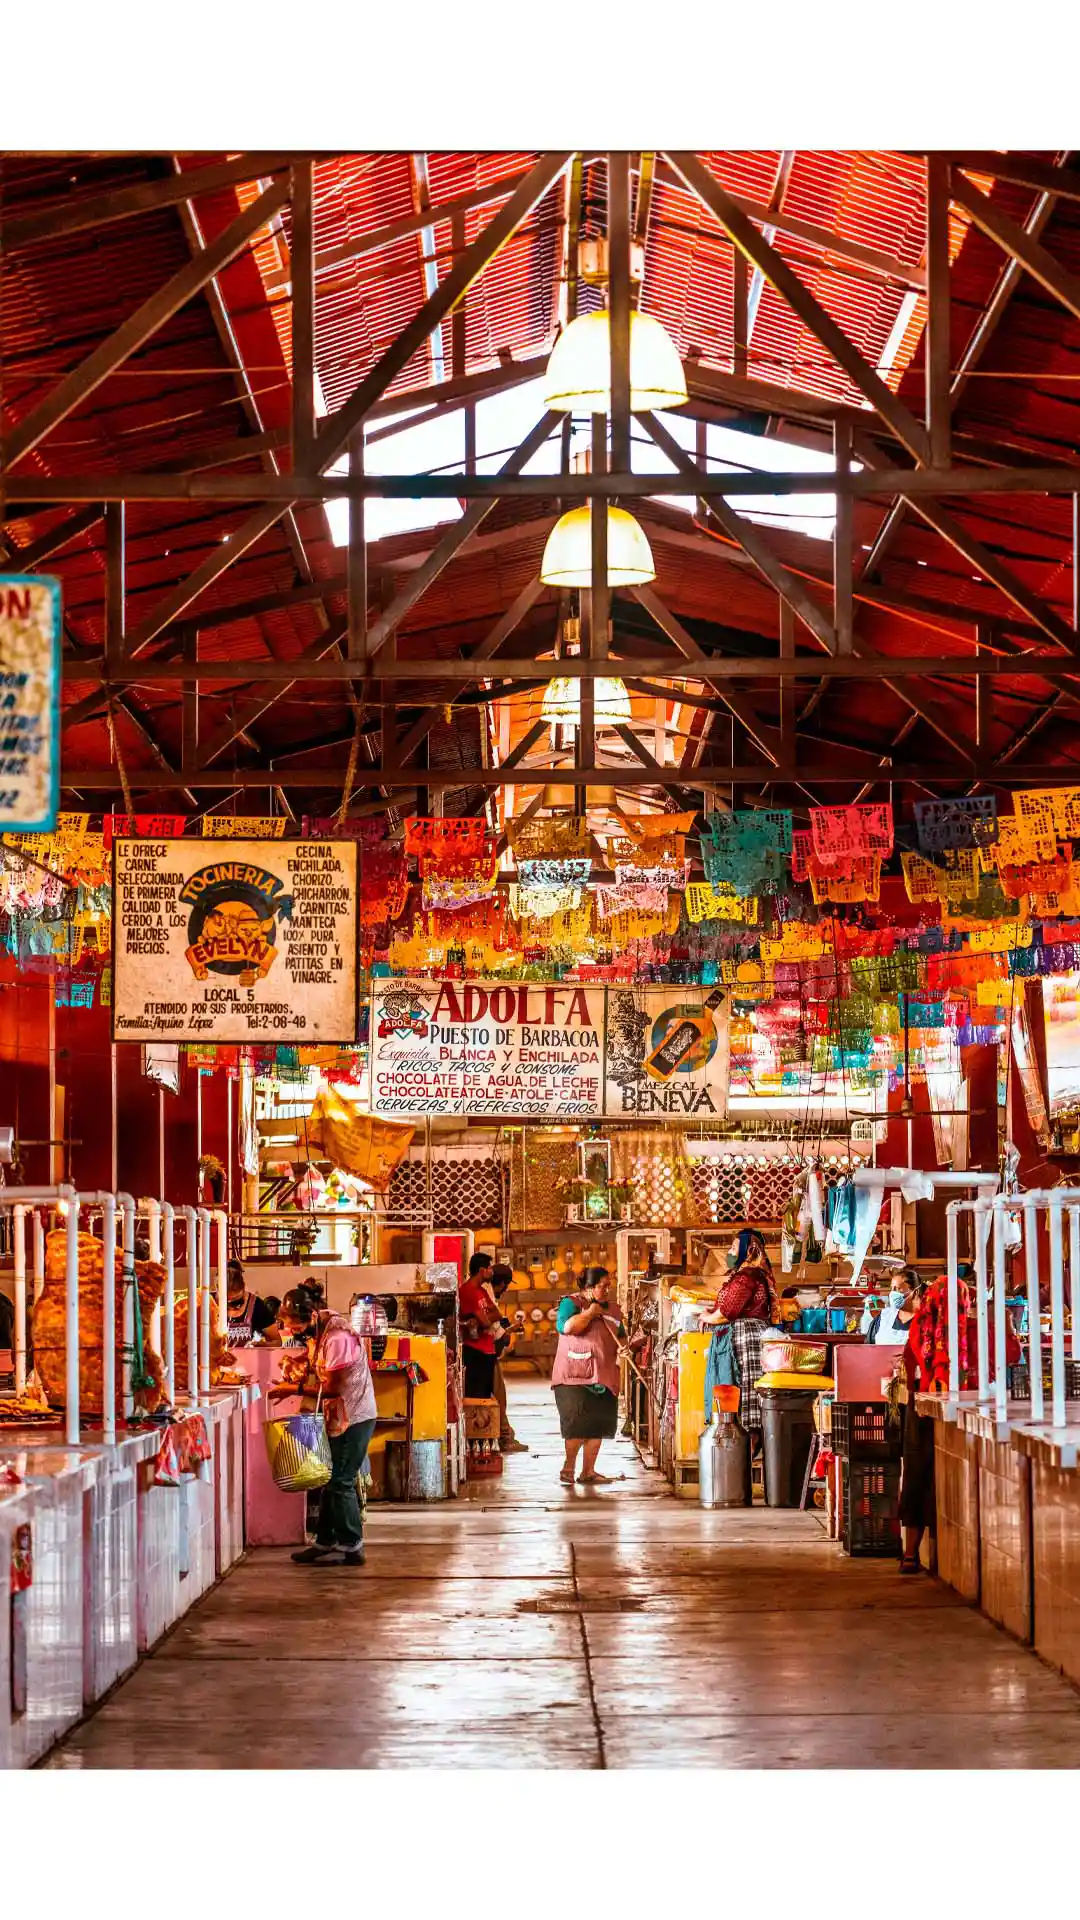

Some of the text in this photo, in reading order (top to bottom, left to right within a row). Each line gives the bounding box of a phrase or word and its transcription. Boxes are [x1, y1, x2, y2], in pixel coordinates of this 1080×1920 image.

[118, 844, 168, 857] LE OFRECE
[125, 859, 157, 871] CARNE
[118, 873, 185, 885] SELECCIONADA
[182, 863, 277, 900] TOCINERIA
[123, 887, 176, 899] DE PRIMERA
[122, 901, 177, 913] CALIDAD DE
[122, 914, 187, 927] CERDO A LOS
[290, 916, 336, 928] MANTECA
[126, 928, 170, 940] MEJORES
[126, 942, 170, 955] PRECIOS.
[192, 937, 269, 962] EVELYN
[287, 943, 341, 956] ASIENTO Y
[285, 957, 343, 970] PATITAS EN
[291, 971, 337, 983] VINAGRE.
[204, 989, 255, 1001] LOCAL 5
[144, 1003, 294, 1014] ATENDIDO POR SUS PROPIETARIOS.
[430, 981, 593, 1026] ADOLFA
[384, 1019, 423, 1028] ADOLFA
[430, 1024, 600, 1048] PUESTO DE BARBACOA
[439, 1046, 496, 1061] BLANCA
[503, 1050, 513, 1061] Y
[519, 1048, 600, 1064] ENCHILADA
[396, 1060, 442, 1072] RICOS
[448, 1061, 495, 1073] TACOS
[514, 1063, 580, 1075] CONSOME
[376, 1072, 457, 1085] CHOCOLATE
[463, 1074, 480, 1086] DE
[529, 1076, 547, 1088] DE
[552, 1076, 599, 1089] LECHE
[641, 1081, 700, 1091] MEZCAL
[621, 1083, 717, 1113] BENEVÁ
[376, 1098, 449, 1111] CERVEZAS
[465, 1100, 550, 1113] REFRESCOS
[555, 1102, 598, 1115] FRIOS
